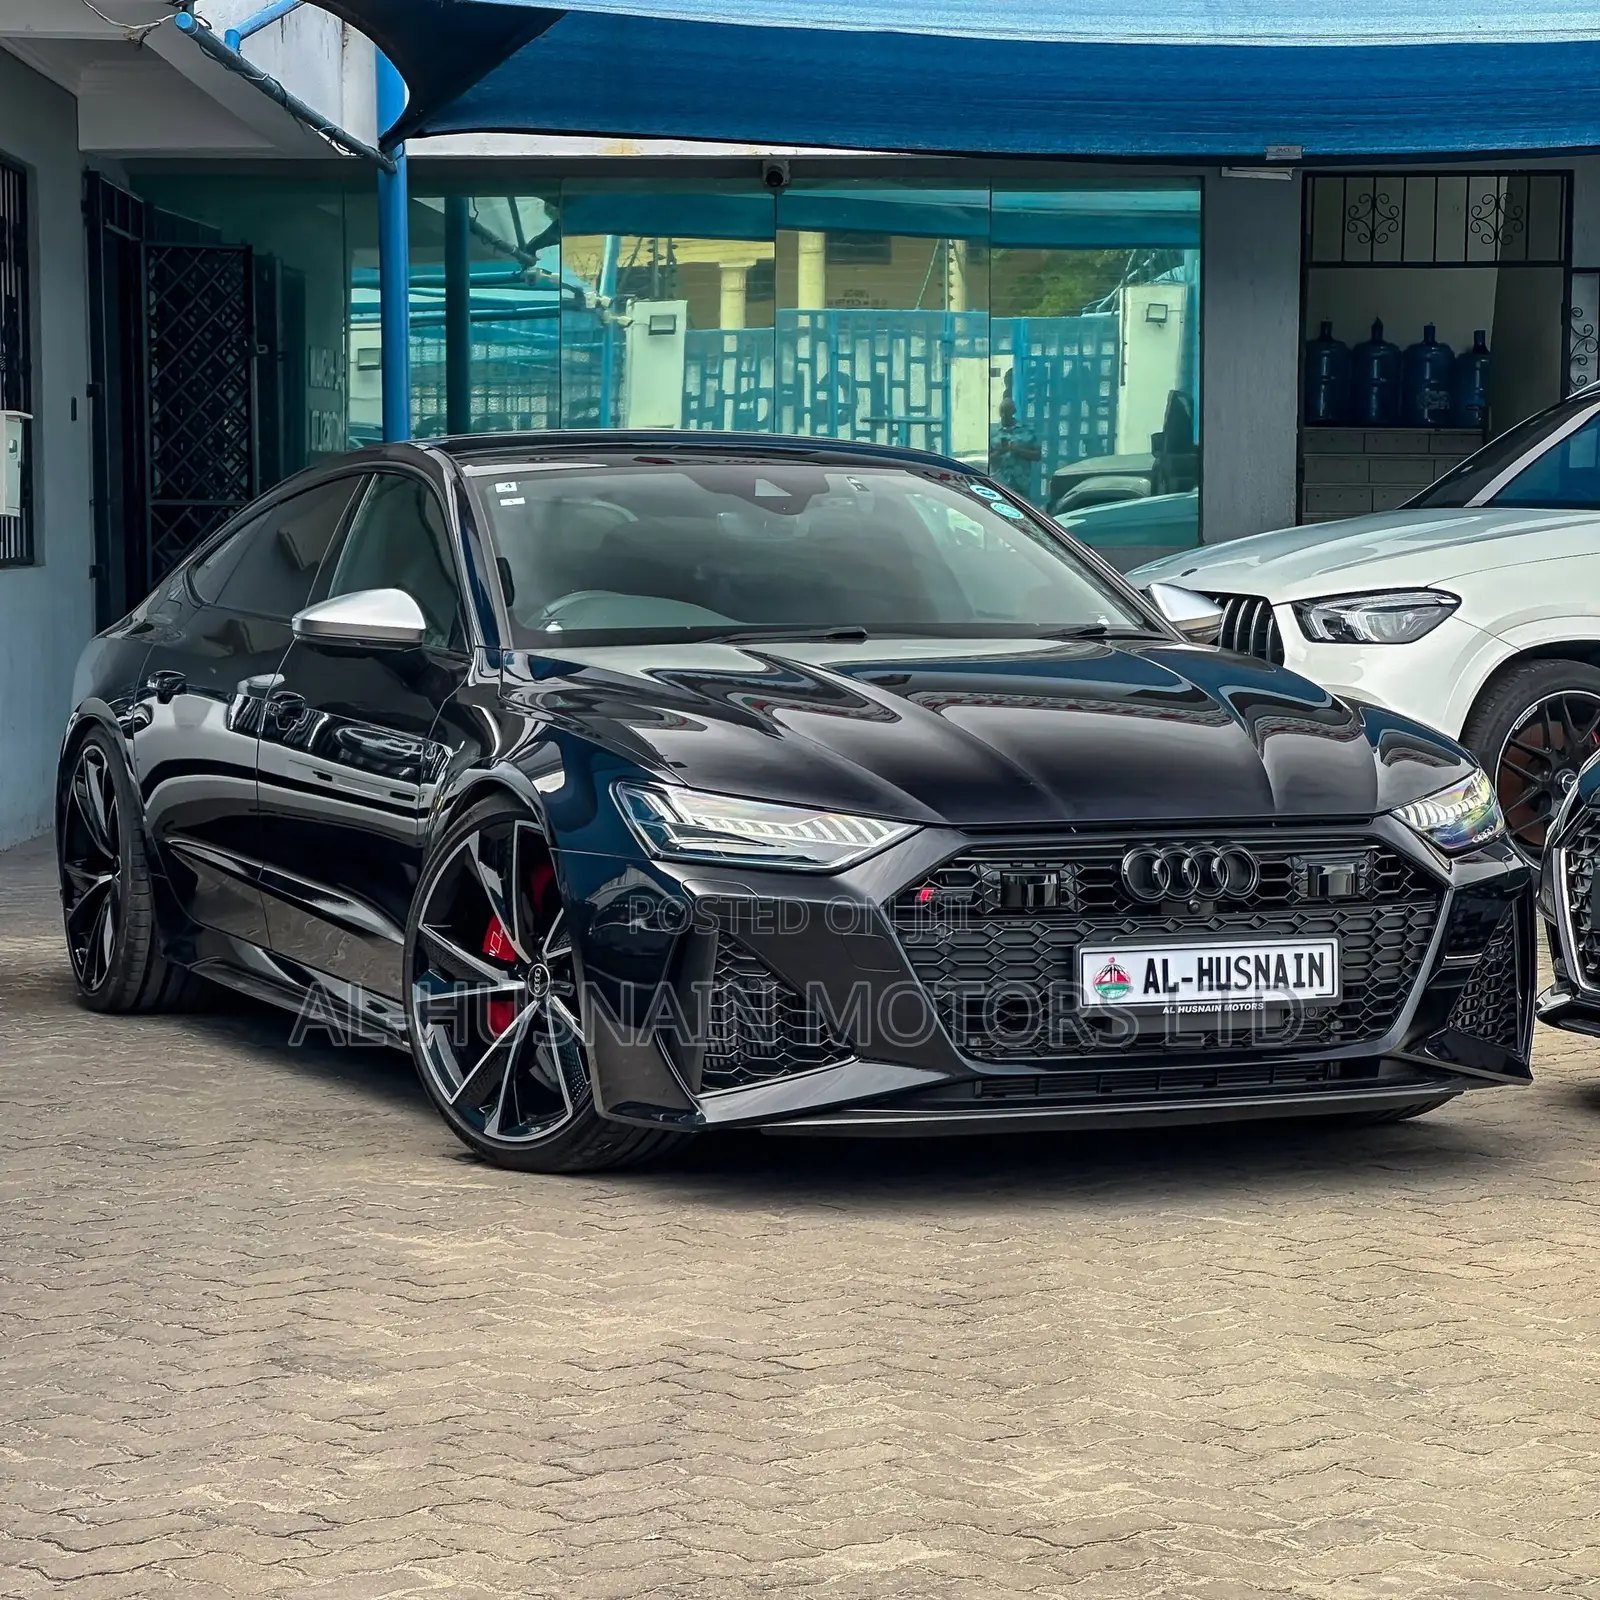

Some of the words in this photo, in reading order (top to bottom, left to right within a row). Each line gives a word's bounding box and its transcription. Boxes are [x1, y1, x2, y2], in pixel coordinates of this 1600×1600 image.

[1143, 952, 1325, 994] AL-HUSNAIN
[1162, 1006, 1176, 1014] AL
[1177, 1004, 1222, 1013] HUSNAIN
[1223, 1002, 1264, 1012] MOTORS
